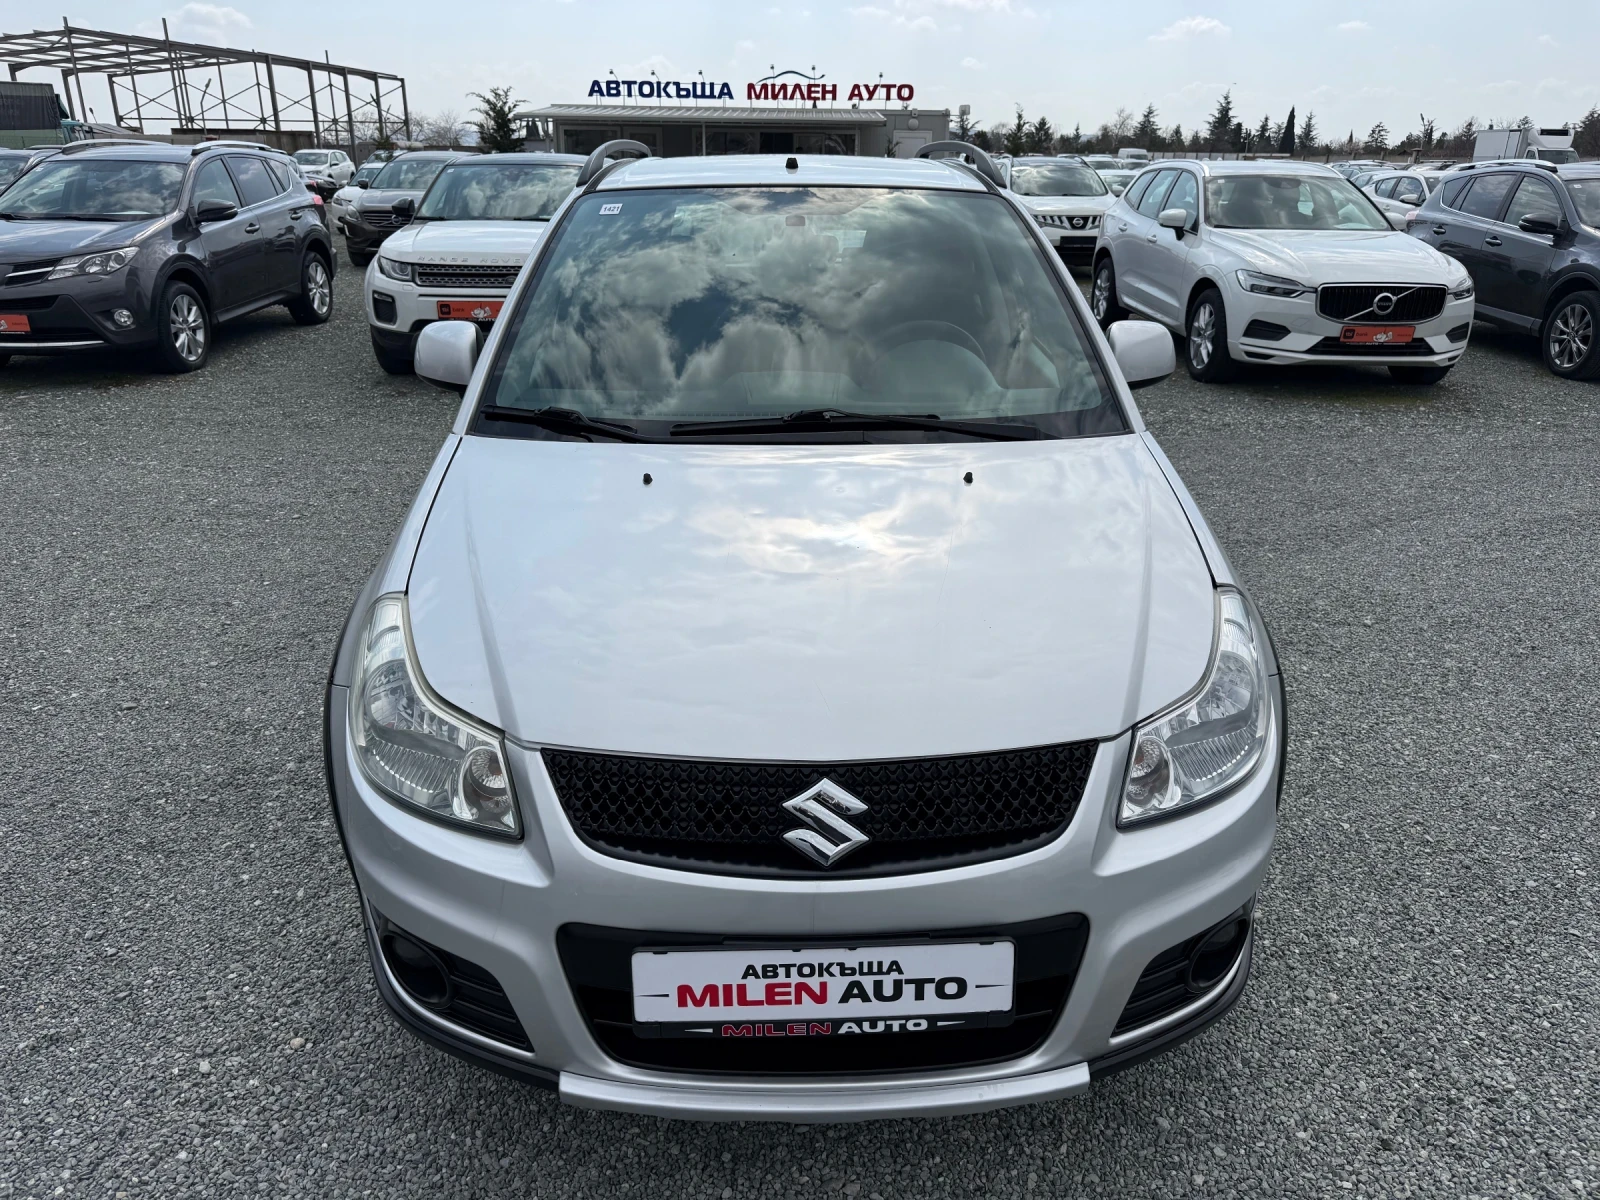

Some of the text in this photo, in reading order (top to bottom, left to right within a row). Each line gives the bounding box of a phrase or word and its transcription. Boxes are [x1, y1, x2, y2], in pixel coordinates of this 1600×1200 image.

[747, 82, 837, 101] МИЛЕН
[847, 83, 914, 102] АУТО
[676, 976, 968, 1008] MILEN AUTO
[721, 1018, 928, 1037] MILEN AUTO
